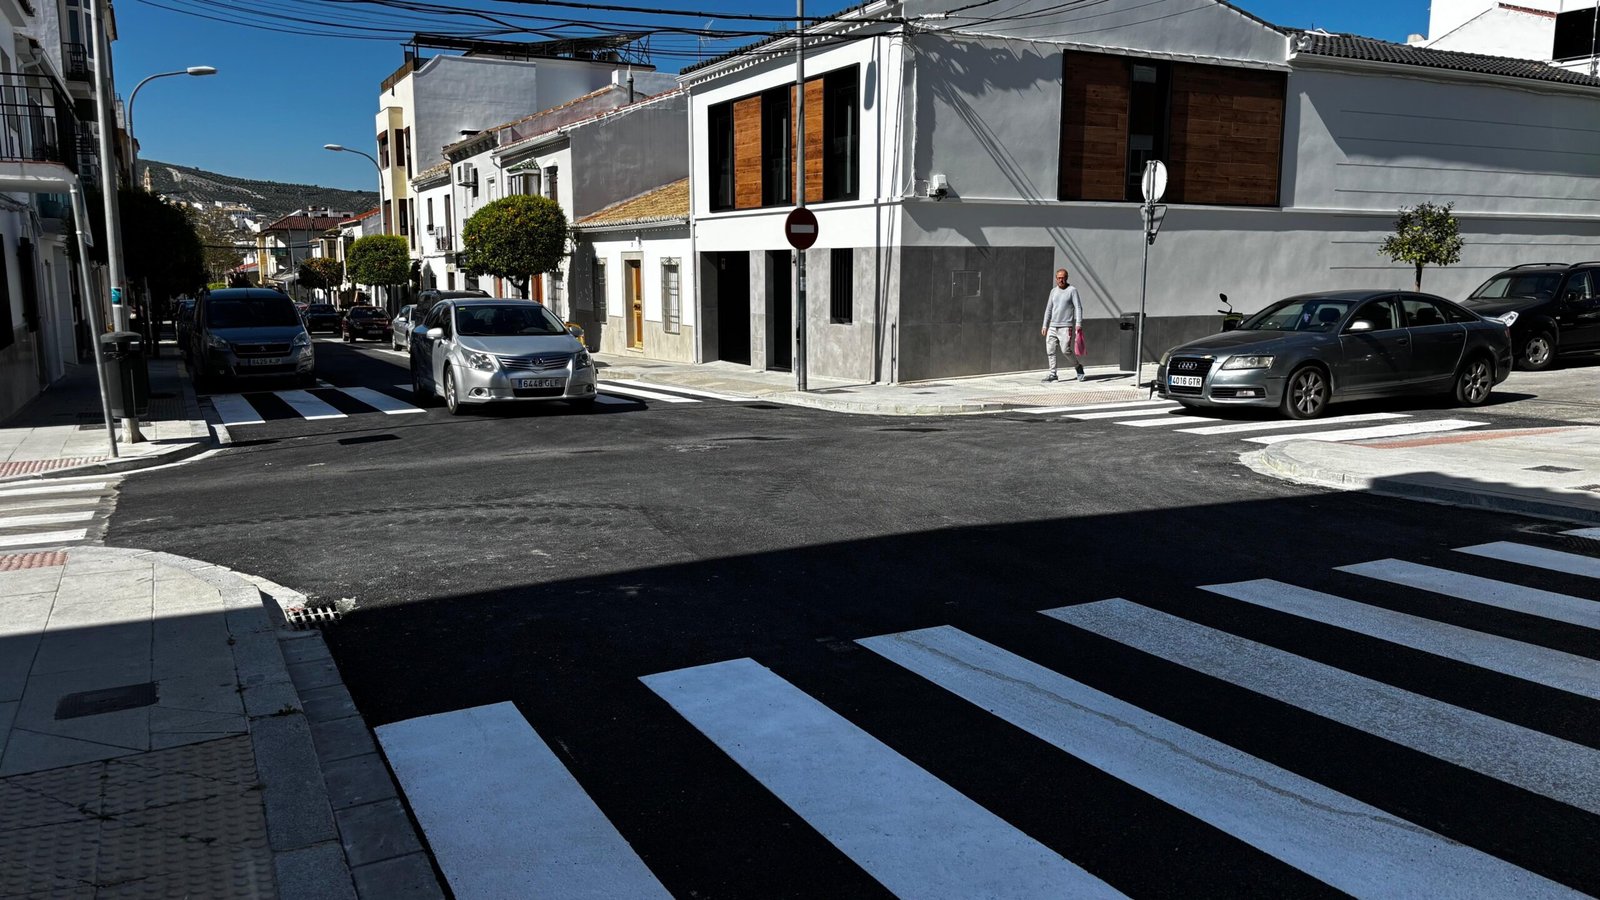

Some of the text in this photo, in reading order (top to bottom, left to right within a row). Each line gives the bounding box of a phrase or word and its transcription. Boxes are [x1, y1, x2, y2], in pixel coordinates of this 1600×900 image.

[523, 379, 560, 388] 6448 GLF
[1172, 376, 1201, 386] 4016 GTR
